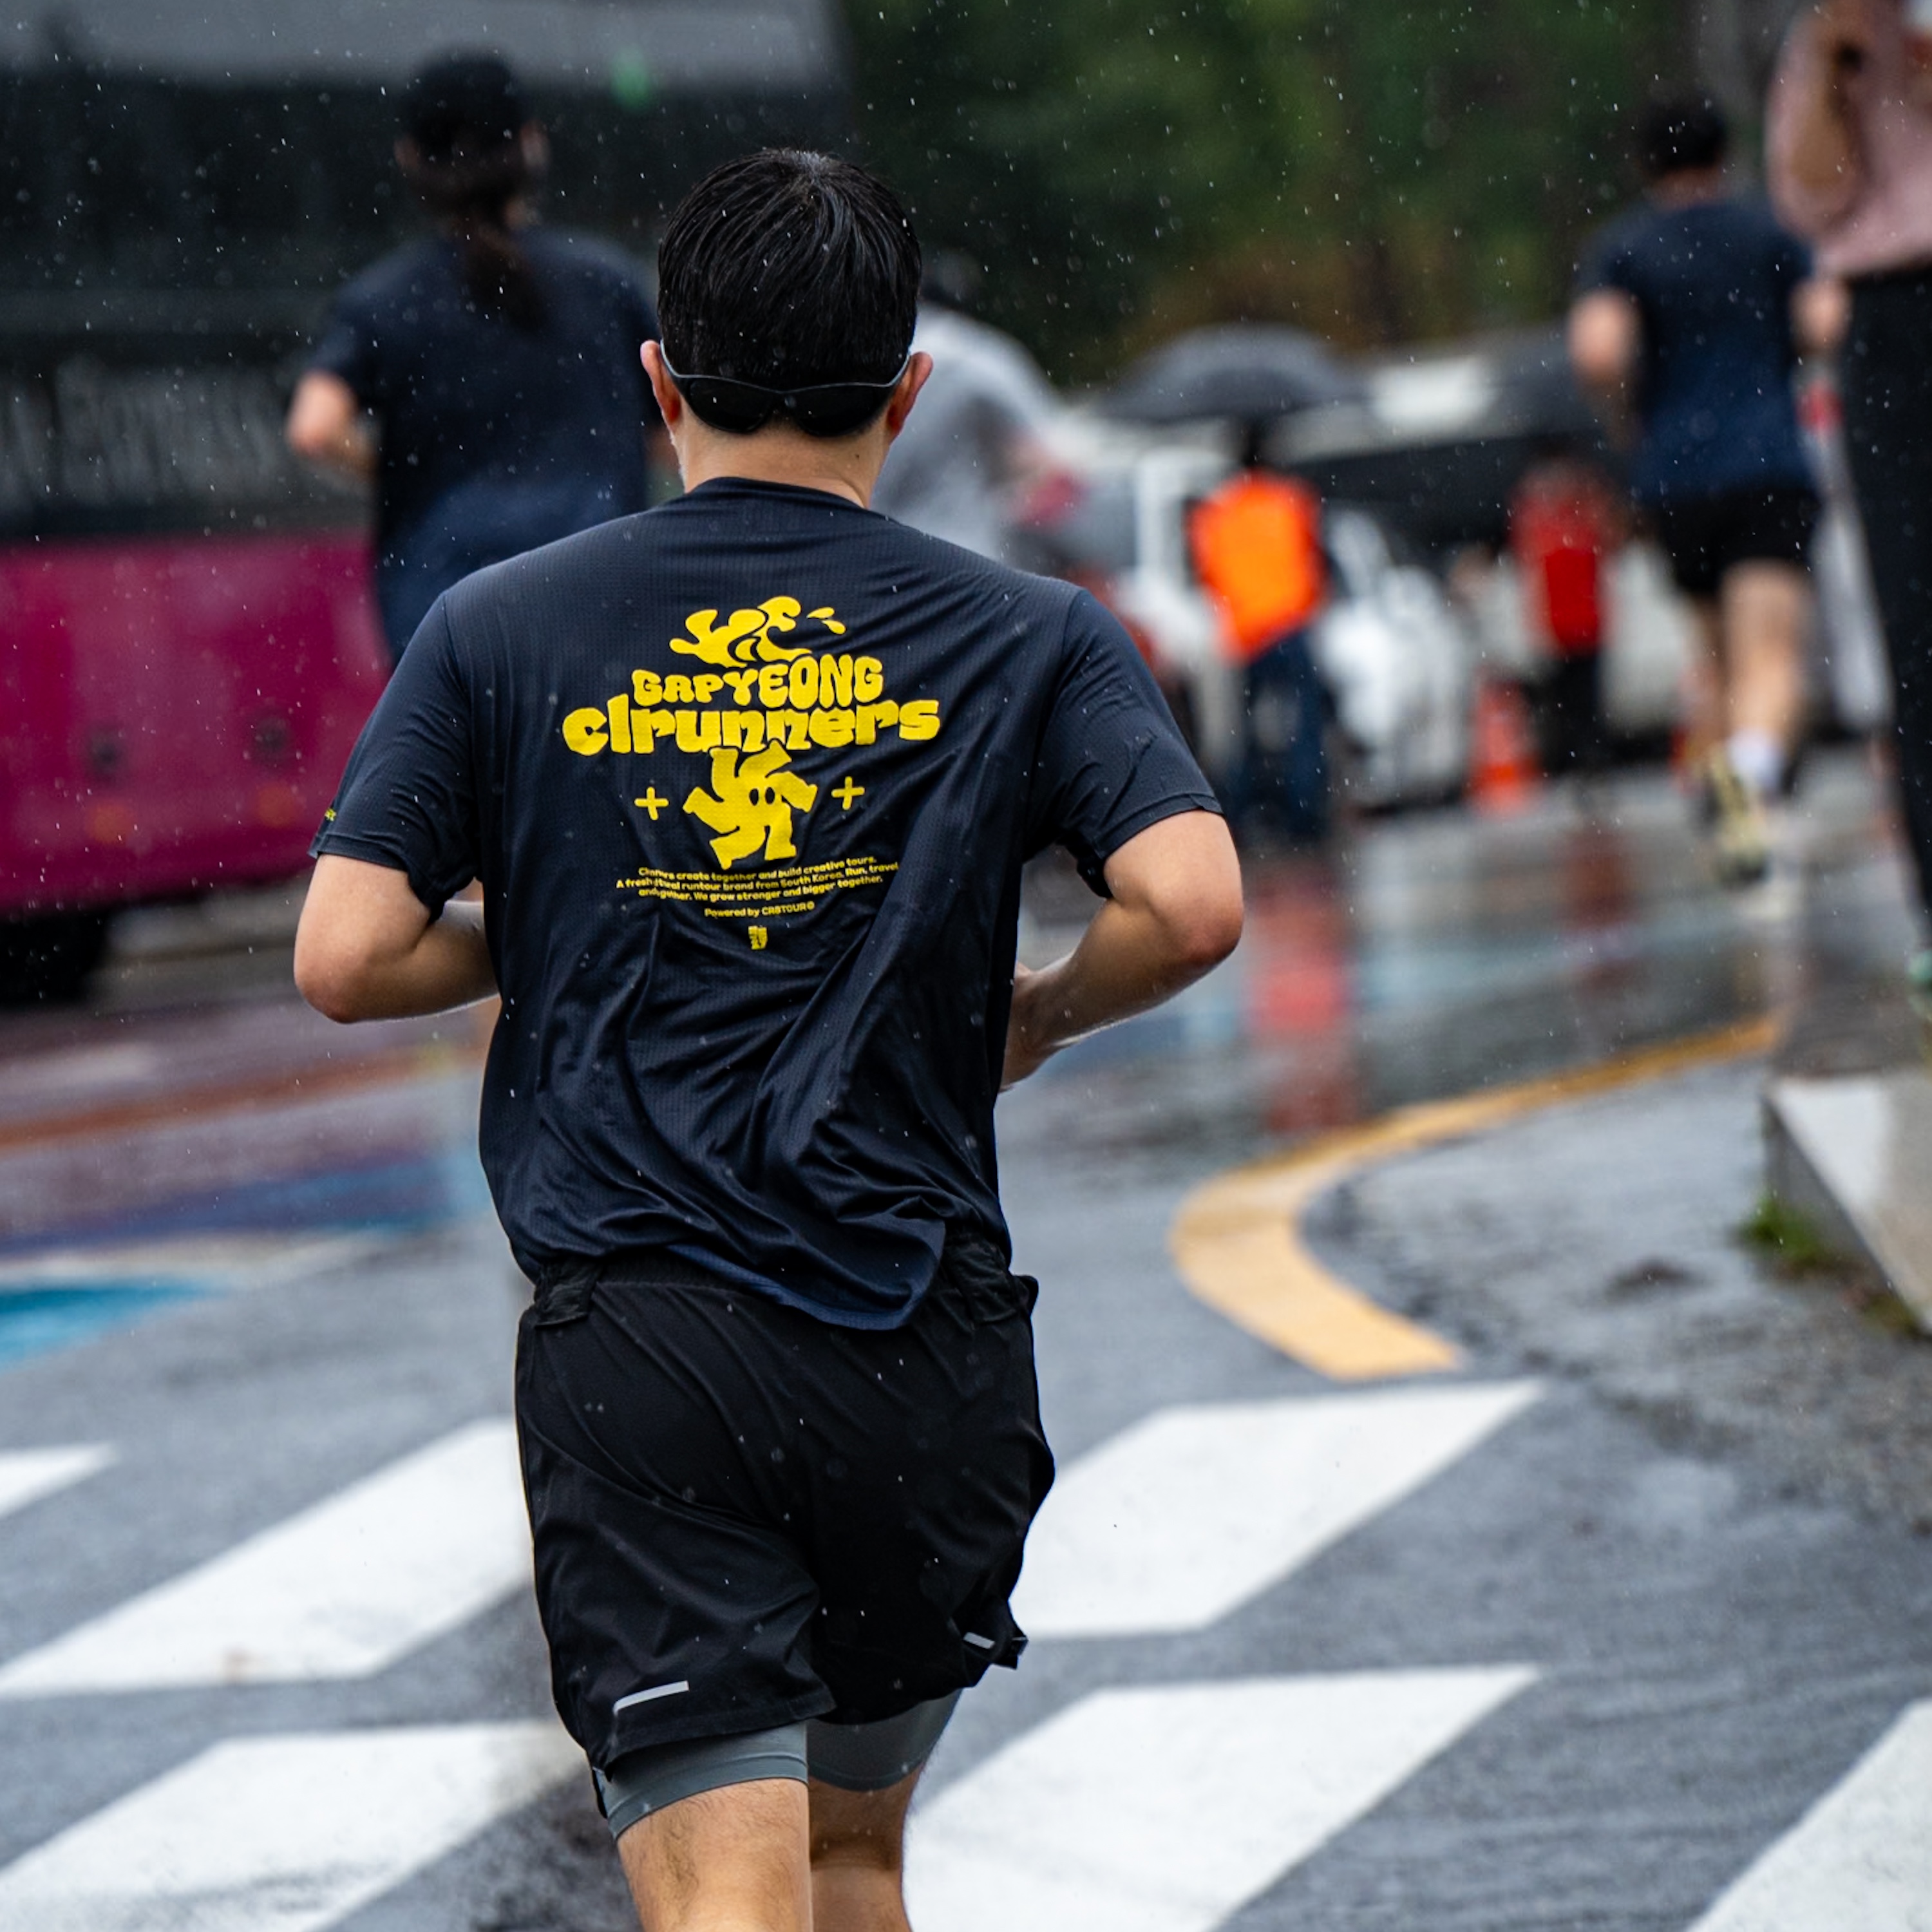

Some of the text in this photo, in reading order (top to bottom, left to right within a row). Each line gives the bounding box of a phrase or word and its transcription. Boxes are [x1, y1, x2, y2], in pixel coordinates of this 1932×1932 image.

[632, 654, 884, 709] GAPYEONG
[562, 693, 940, 756] clrunners
[616, 879, 624, 888] A
[625, 877, 652, 888] fresh
[681, 882, 721, 891] runtour
[723, 882, 753, 891] brand
[755, 880, 779, 889] from
[780, 875, 811, 888] South
[869, 862, 899, 873] travel
[676, 871, 710, 881] create
[711, 872, 757, 883] together
[758, 870, 777, 880] and
[778, 866, 802, 878] build
[803, 860, 845, 874] creative
[846, 856, 876, 866] tours.
[709, 893, 735, 903] grow
[736, 890, 781, 901] stronger
[782, 886, 801, 897] and
[802, 882, 836, 895] bigger
[837, 875, 884, 888] together.
[705, 908, 746, 917] Powered
[747, 908, 760, 918] by
